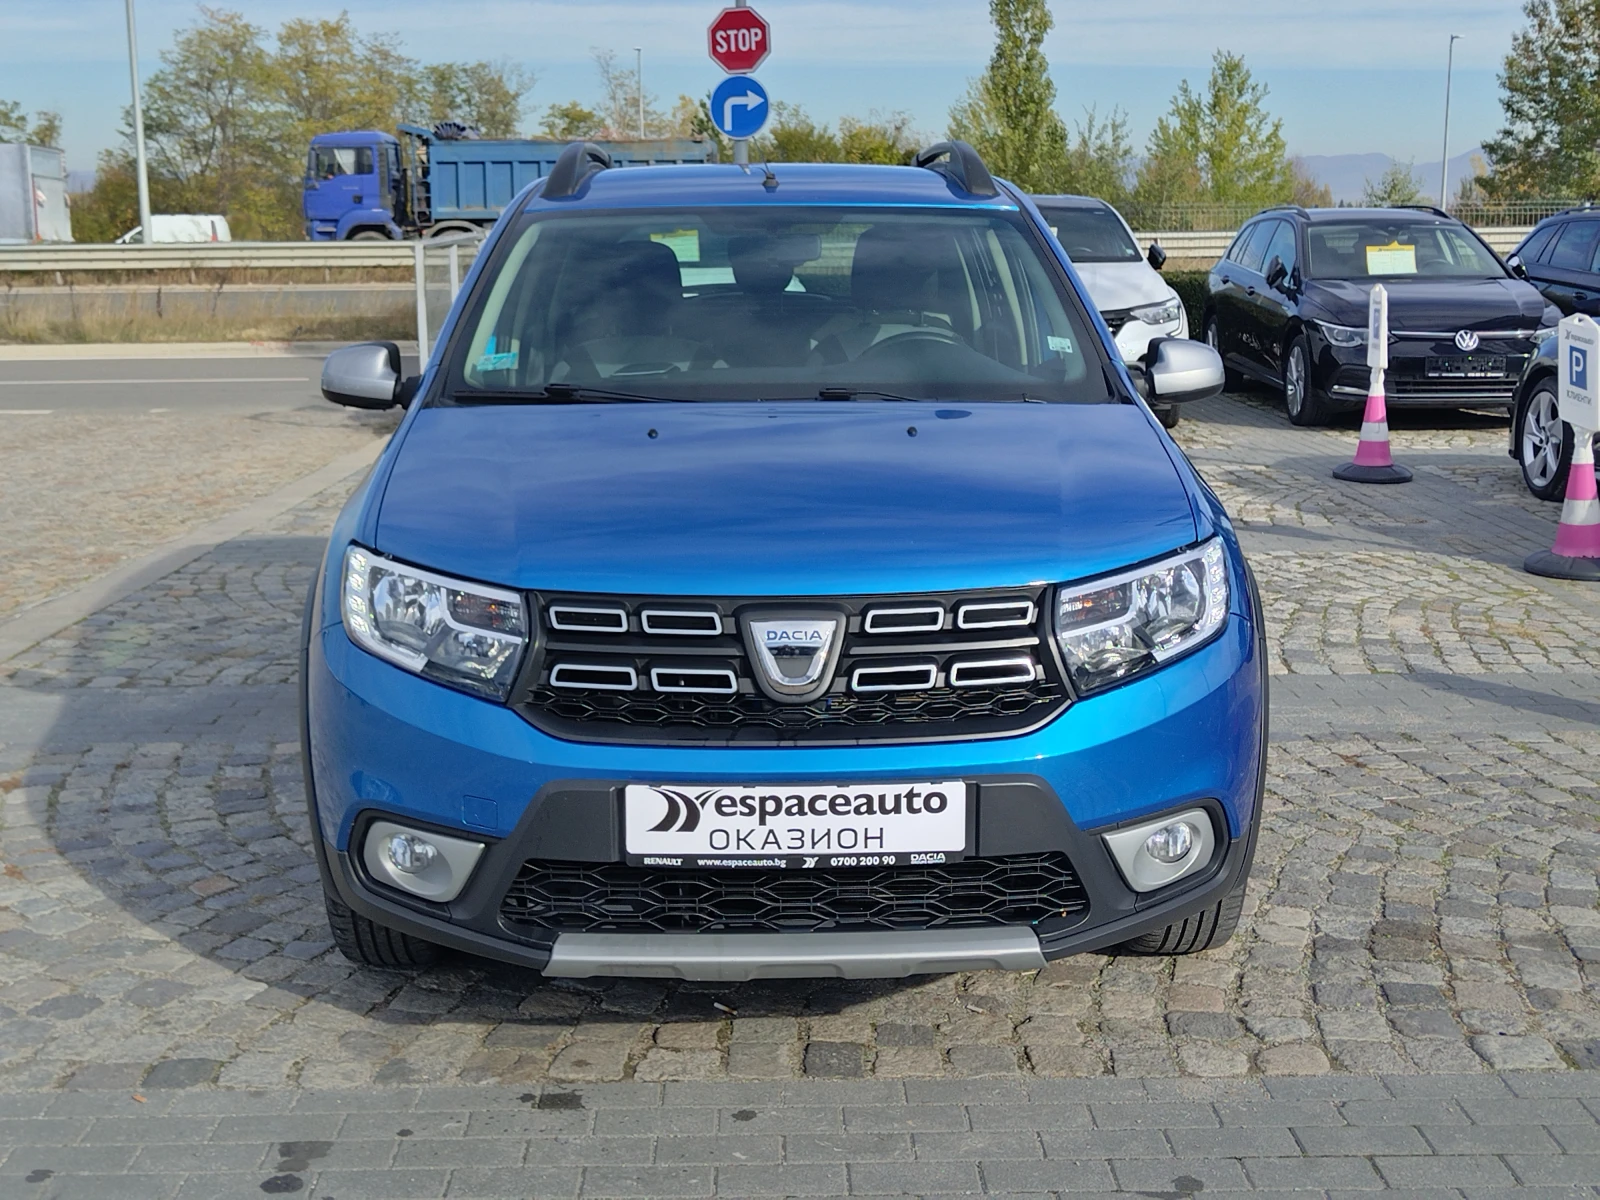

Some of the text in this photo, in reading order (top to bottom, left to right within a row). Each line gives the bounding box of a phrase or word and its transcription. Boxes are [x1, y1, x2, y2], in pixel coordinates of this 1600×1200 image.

[715, 27, 762, 53] STOP
[1572, 350, 1584, 382] P
[766, 630, 822, 641] DACIA
[714, 786, 948, 826] espaceauto
[708, 827, 884, 851] ОКАЗИОН
[643, 857, 683, 866] RENAULT
[830, 855, 896, 866] 0700 200 90
[910, 852, 946, 860] DACIA
[697, 857, 787, 868] www.espaceauto.bg
